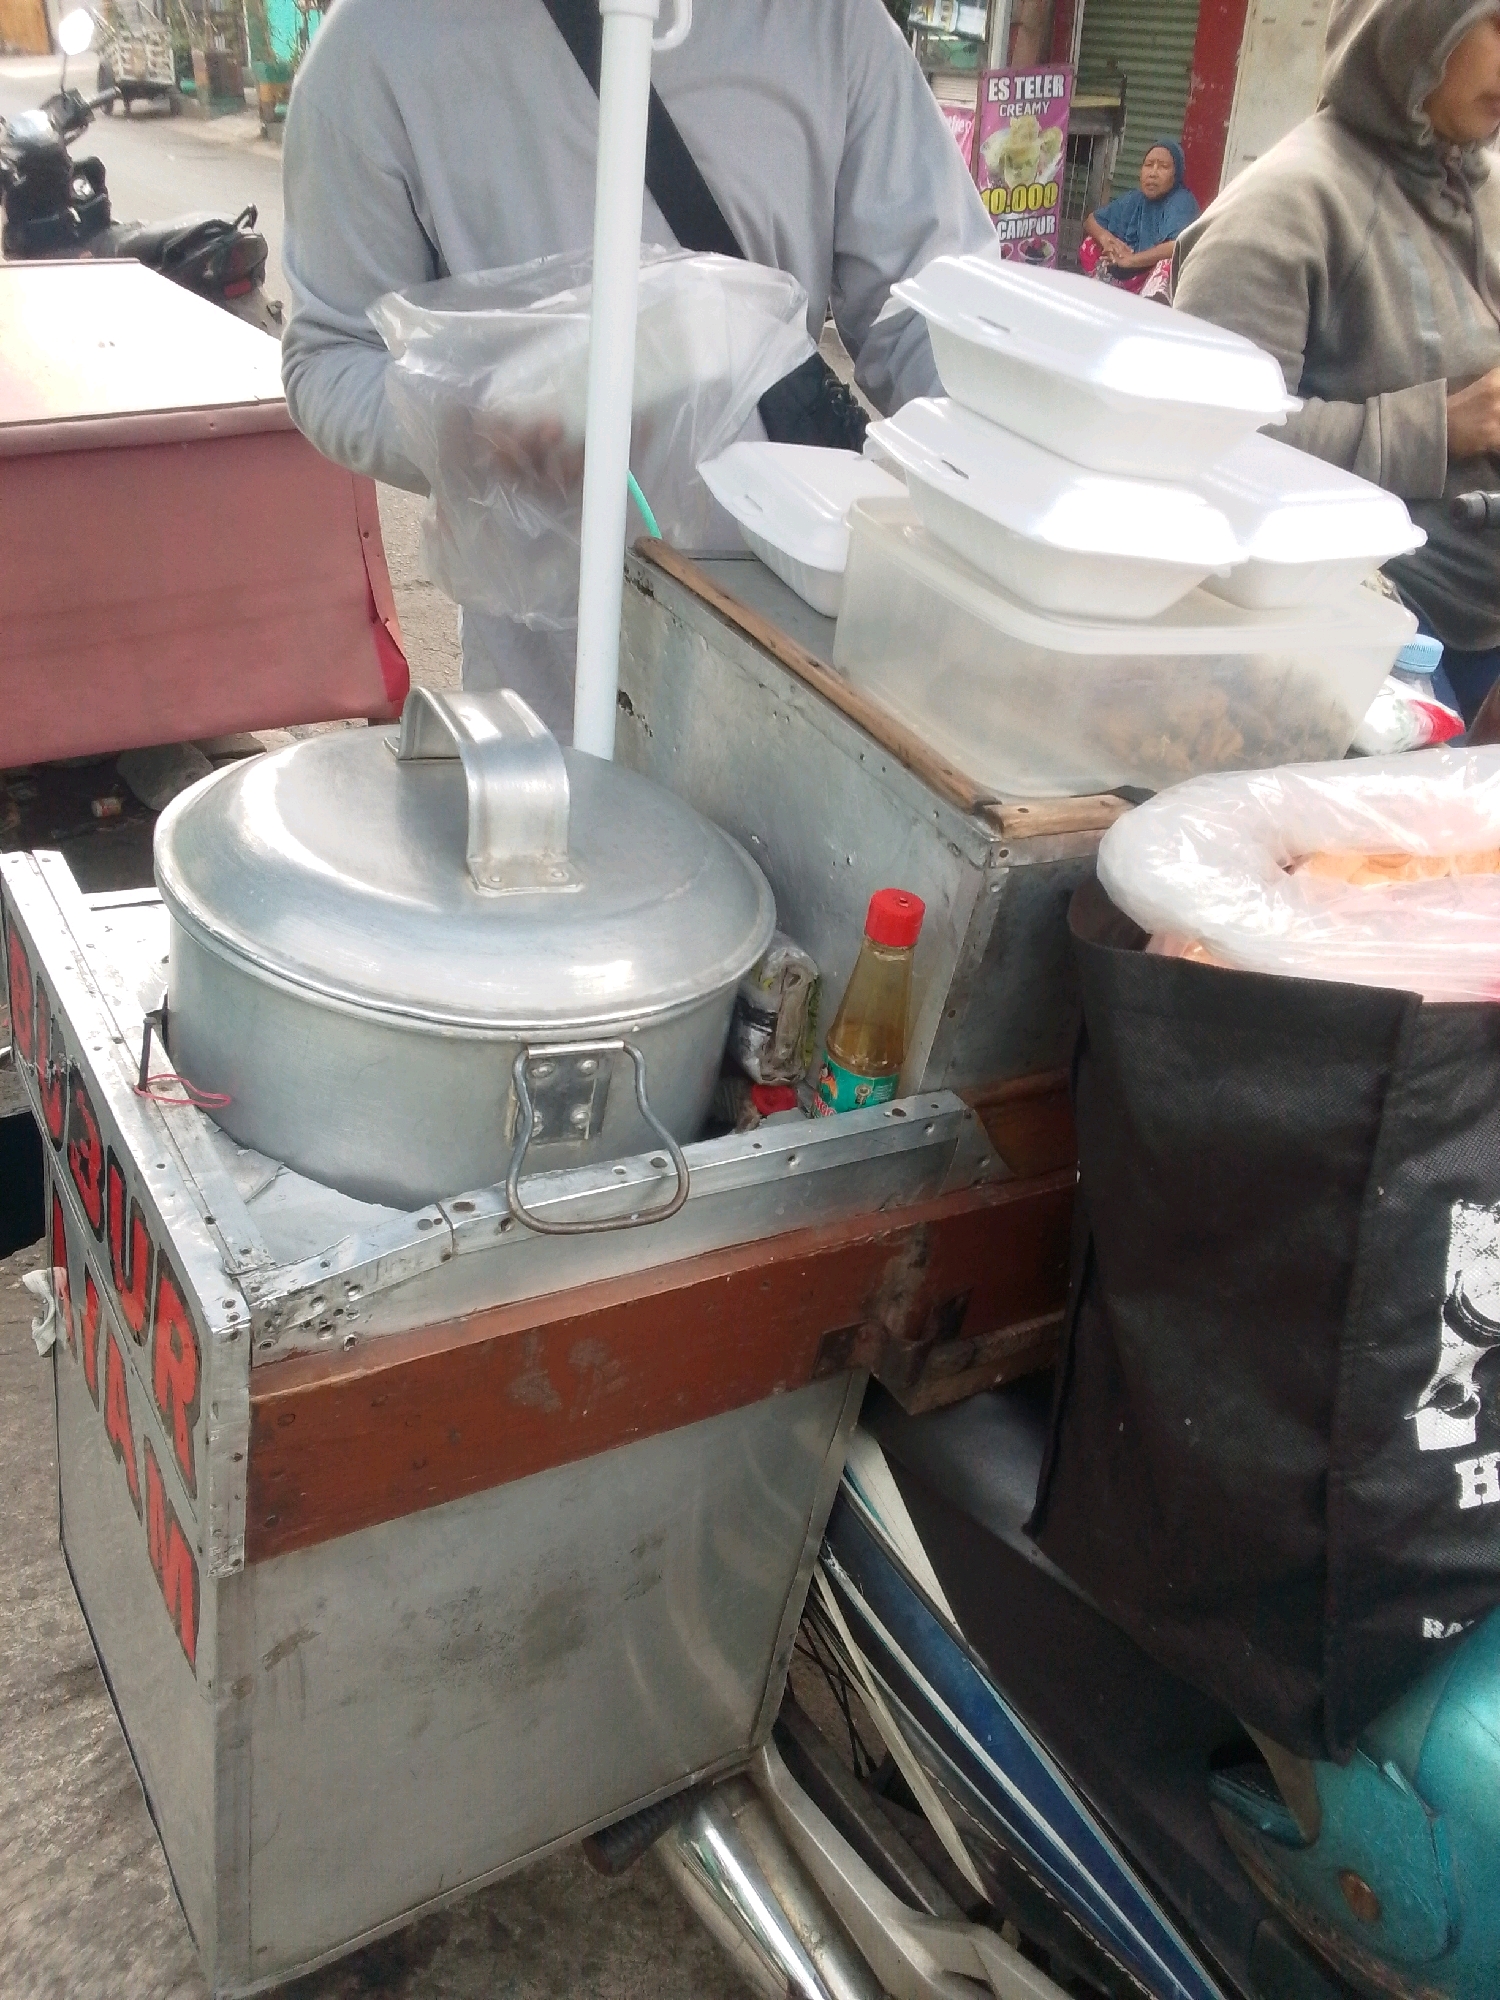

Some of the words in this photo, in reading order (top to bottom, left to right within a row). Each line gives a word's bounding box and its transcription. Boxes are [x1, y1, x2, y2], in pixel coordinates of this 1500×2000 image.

[988, 76, 1010, 102] ES
[1014, 74, 1065, 100] TELER
[999, 101, 1050, 117] CREAMY
[980, 181, 1059, 215] 10.000
[996, 215, 1056, 241] CAMPUR
